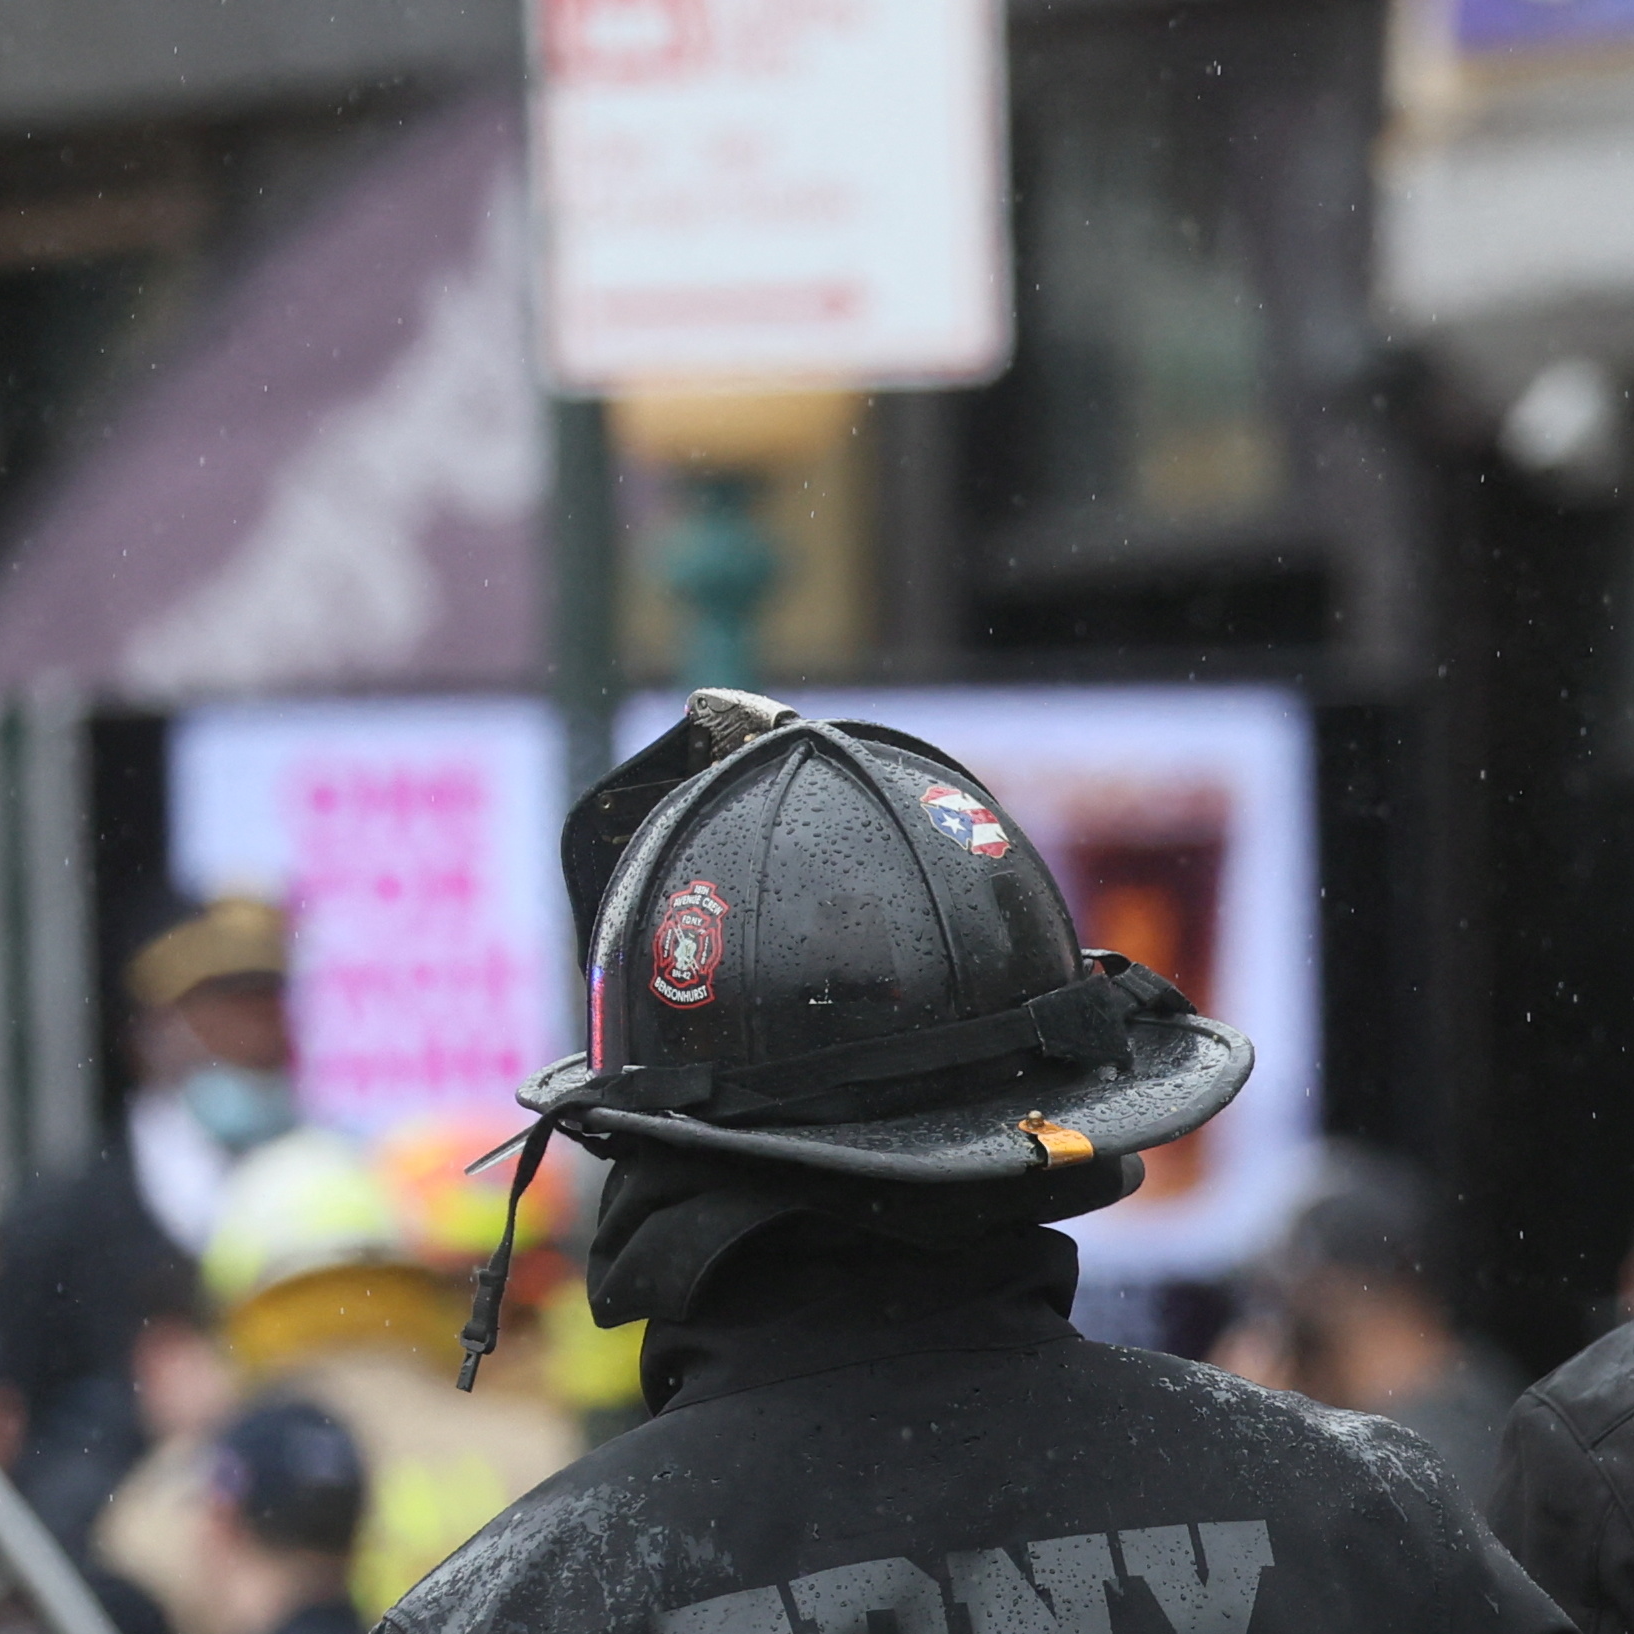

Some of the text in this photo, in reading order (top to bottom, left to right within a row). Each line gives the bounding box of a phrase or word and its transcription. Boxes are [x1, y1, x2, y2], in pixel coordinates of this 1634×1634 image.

[673, 895, 702, 908] AVENUE
[681, 915, 703, 927] FDNY
[654, 976, 708, 1003] BENSONHURST
